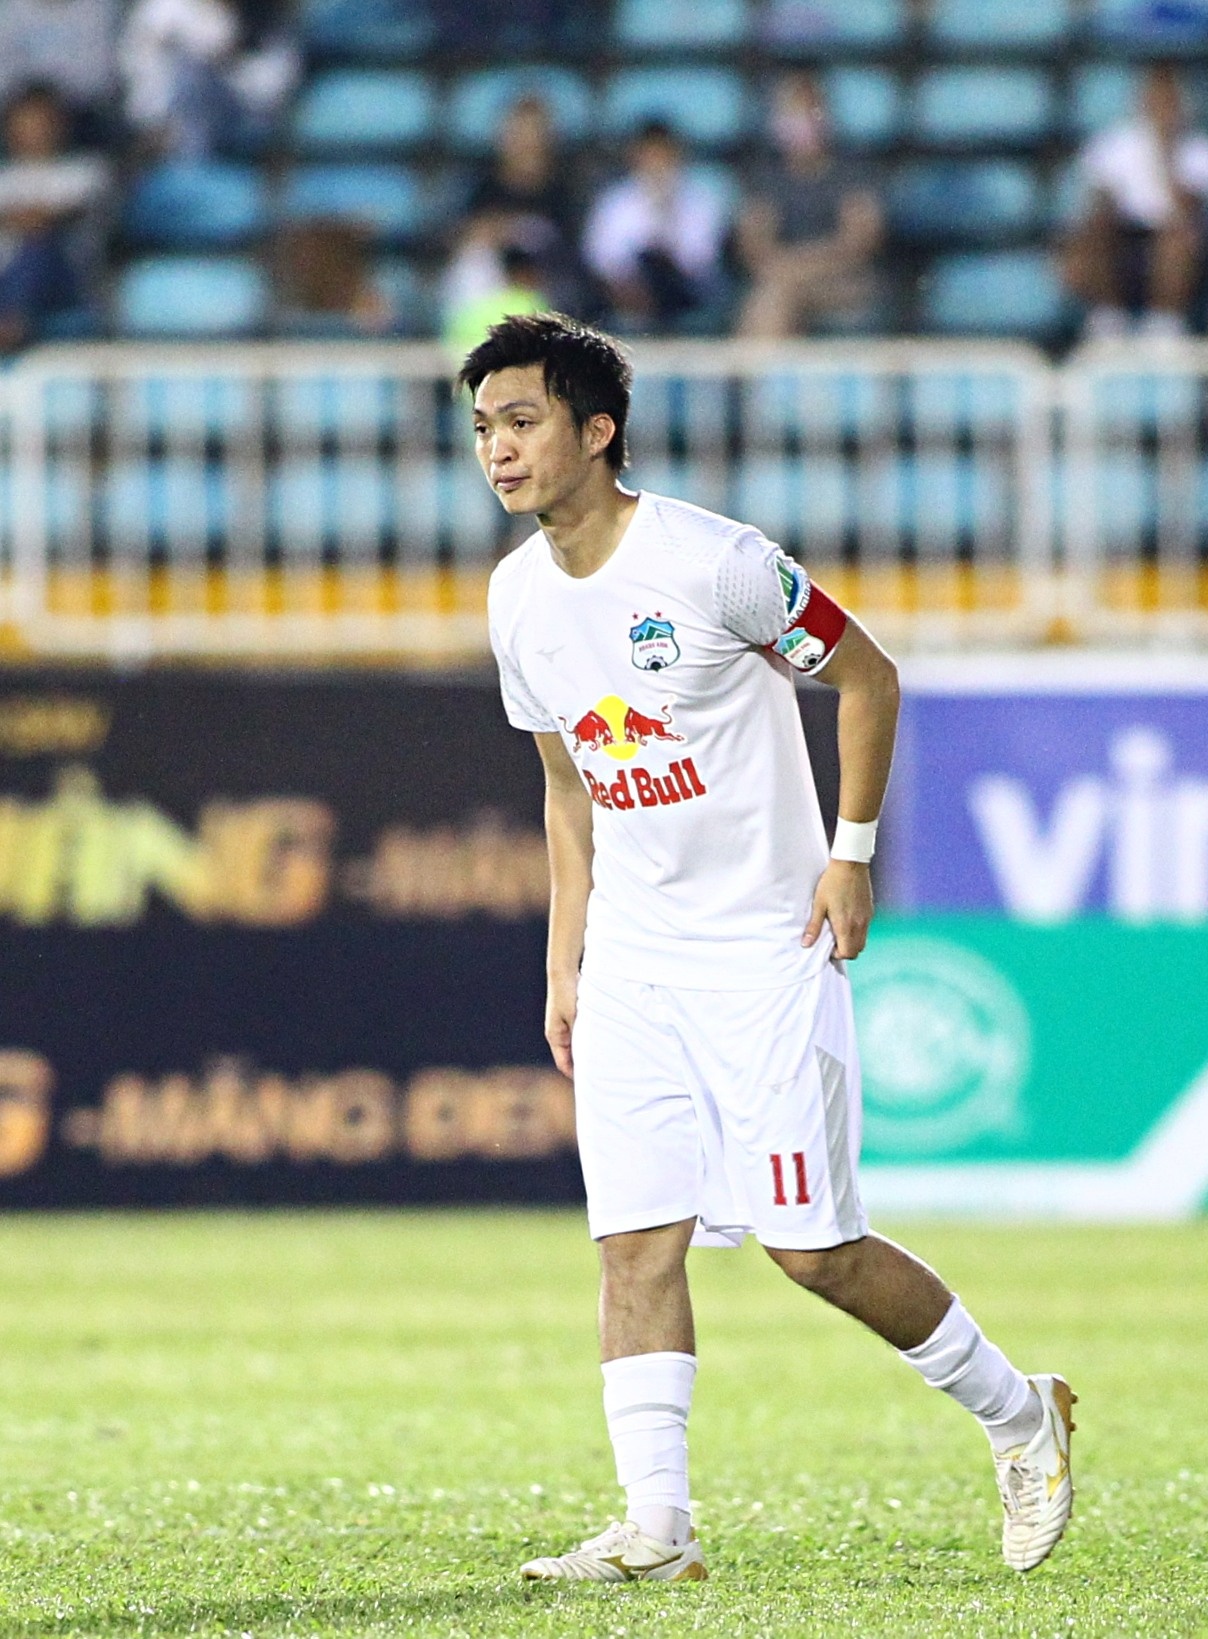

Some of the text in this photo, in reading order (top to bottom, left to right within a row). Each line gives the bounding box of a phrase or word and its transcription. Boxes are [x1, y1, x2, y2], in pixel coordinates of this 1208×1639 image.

[582, 757, 706, 811] Red Bull
[769, 1151, 810, 1205] 11
